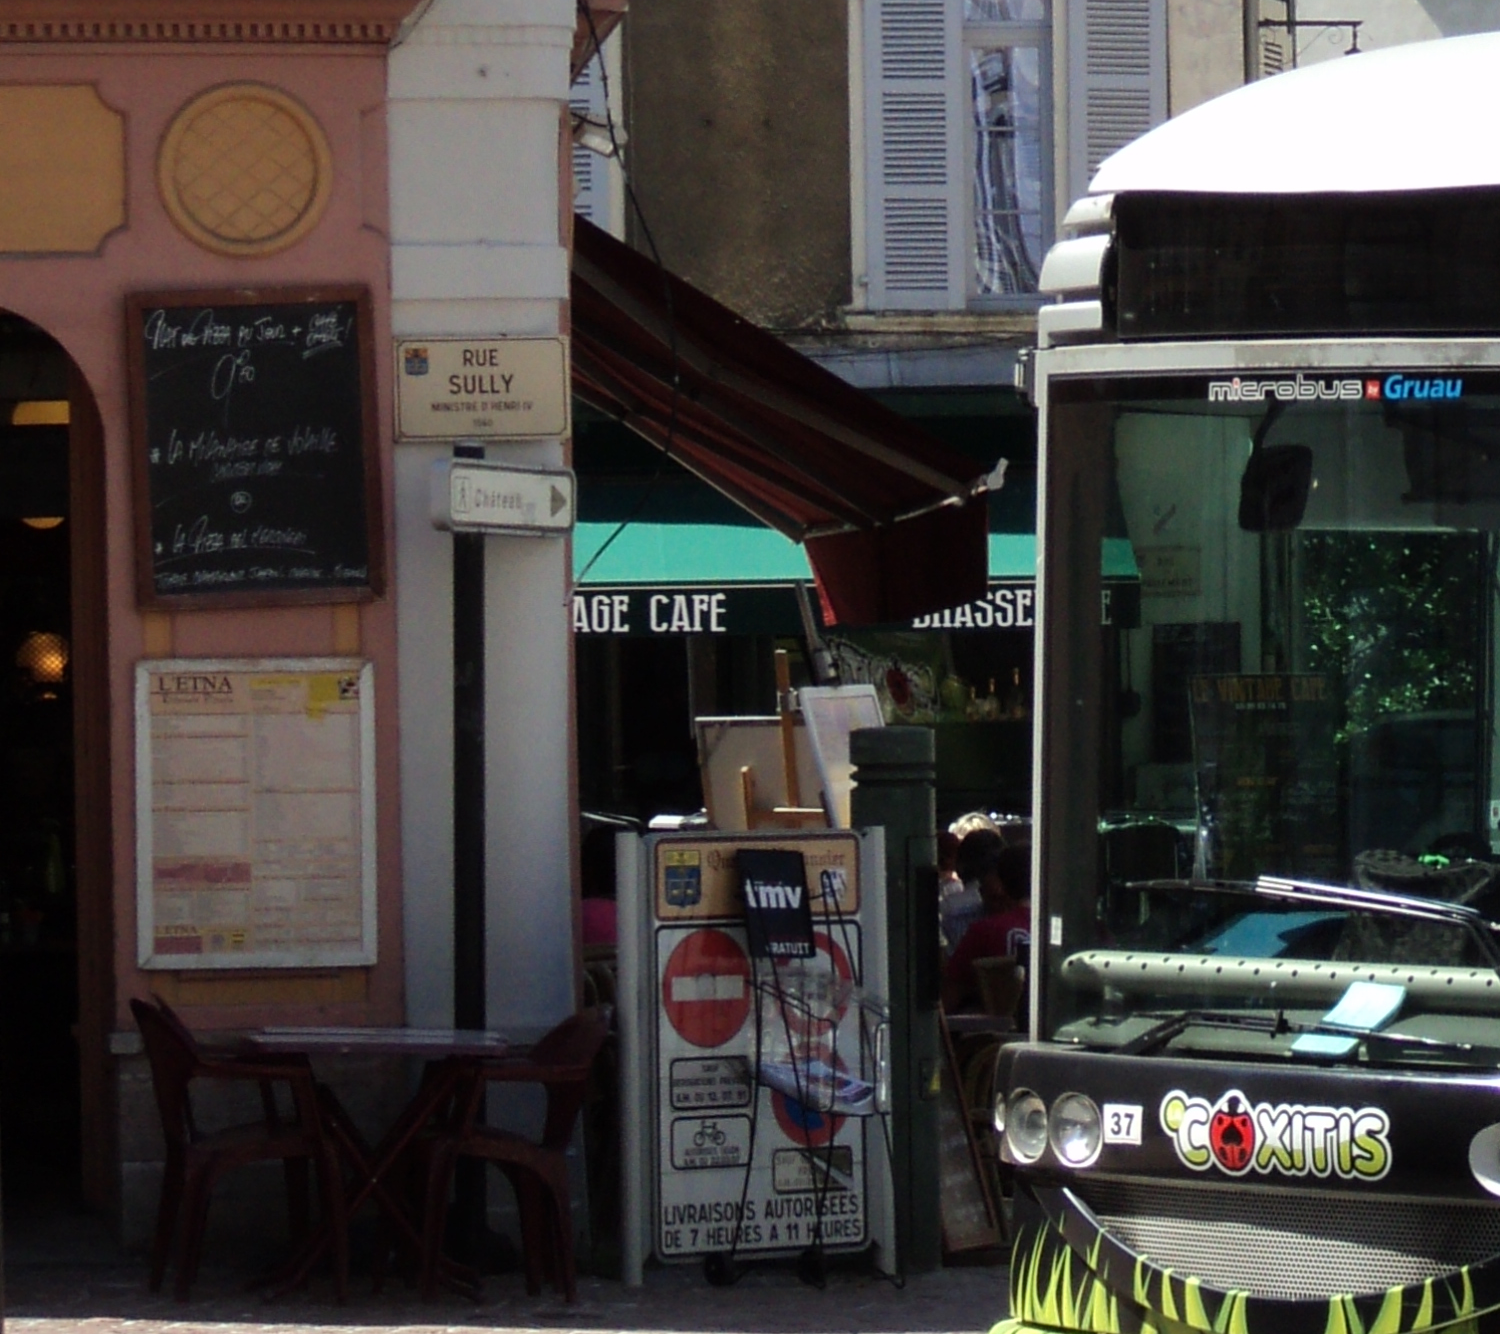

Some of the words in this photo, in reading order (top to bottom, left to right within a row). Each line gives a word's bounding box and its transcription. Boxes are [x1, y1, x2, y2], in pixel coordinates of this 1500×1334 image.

[462, 349, 499, 367] RUE
[448, 373, 515, 395] SULLY
[1208, 373, 1362, 402] microbus
[1384, 374, 1462, 401] Gruau
[430, 401, 478, 412] MINISTRE
[649, 592, 727, 633] CAFÉ
[158, 675, 233, 693] L'ETNA
[1110, 1111, 1135, 1137] 37
[663, 1201, 756, 1226] LIVRAISONS
[664, 1230, 682, 1249] DE
[690, 1229, 699, 1246] 7
[706, 1224, 762, 1247] HEURES
[769, 1224, 779, 1241] A
[785, 1222, 800, 1241] 11
